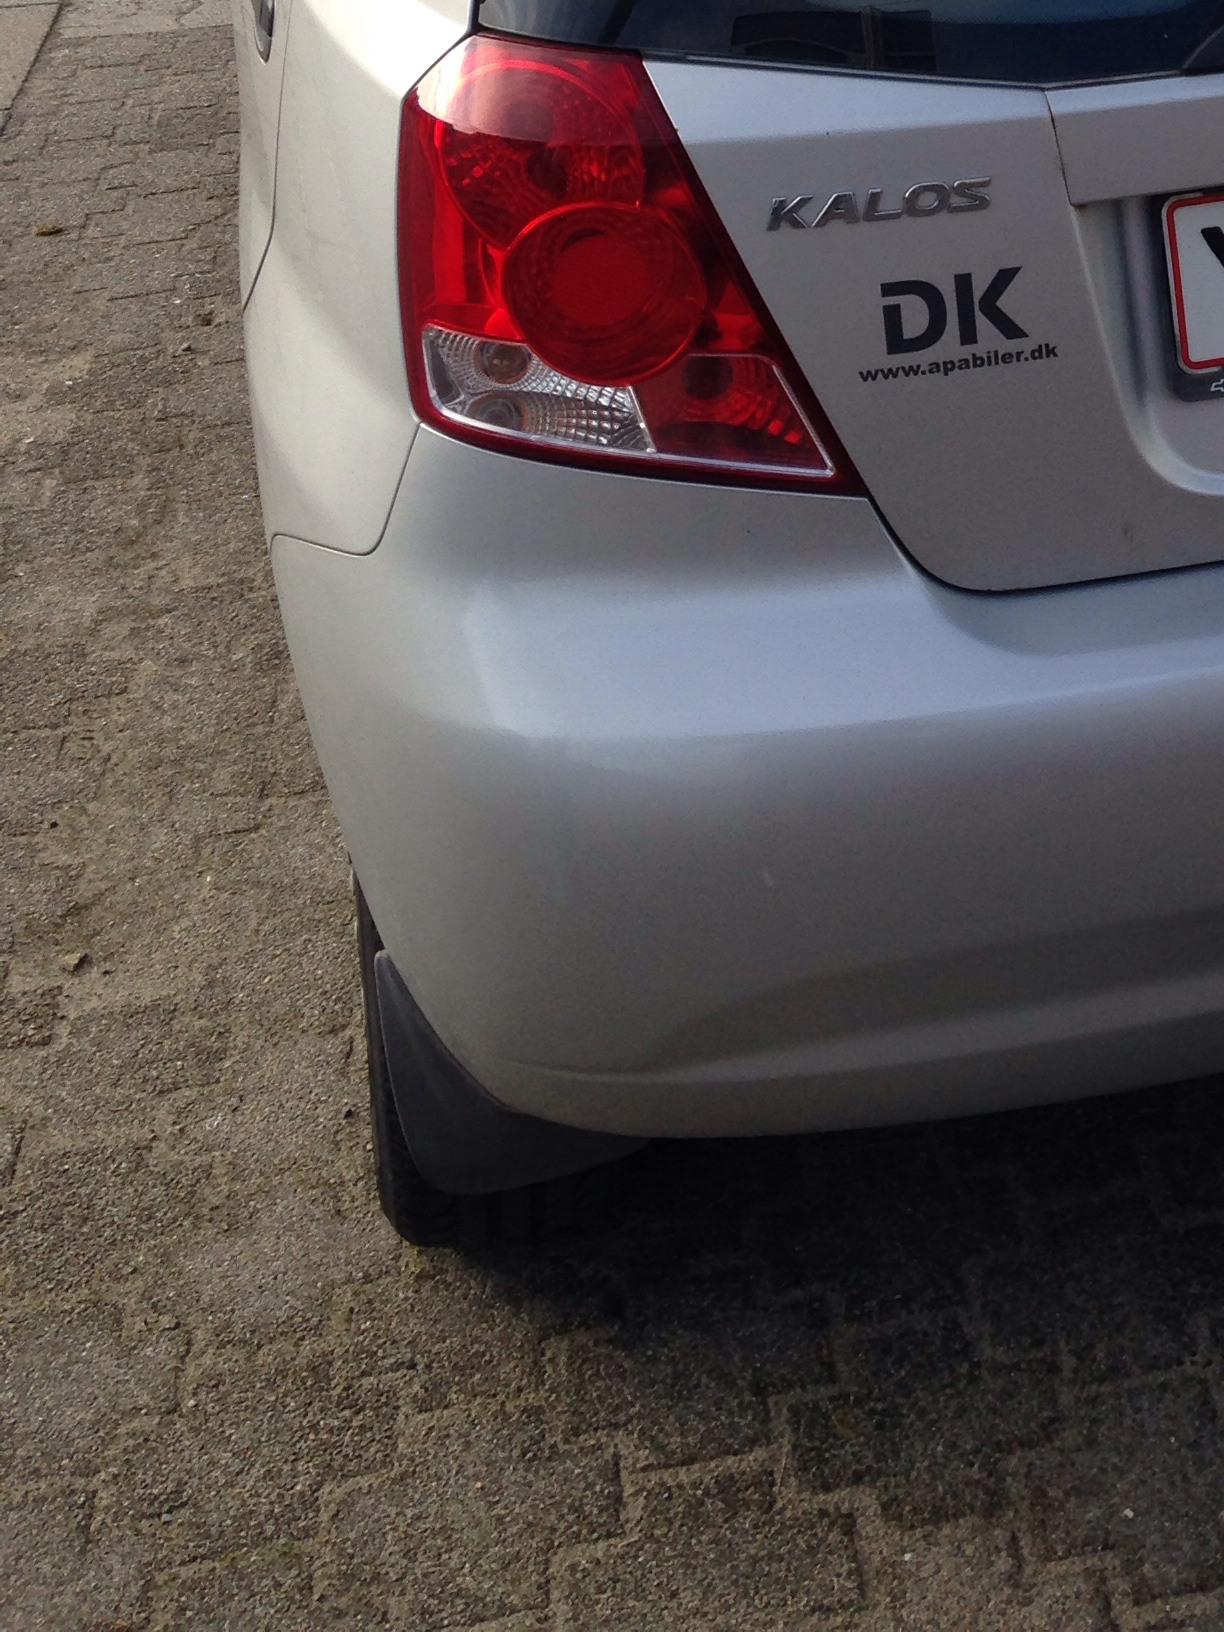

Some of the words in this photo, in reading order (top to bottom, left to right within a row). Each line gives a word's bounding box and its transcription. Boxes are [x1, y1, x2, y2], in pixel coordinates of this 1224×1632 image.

[765, 176, 993, 232] KALOS
[879, 265, 1030, 356] DK
[858, 343, 1060, 383] www.apabiler.dk
